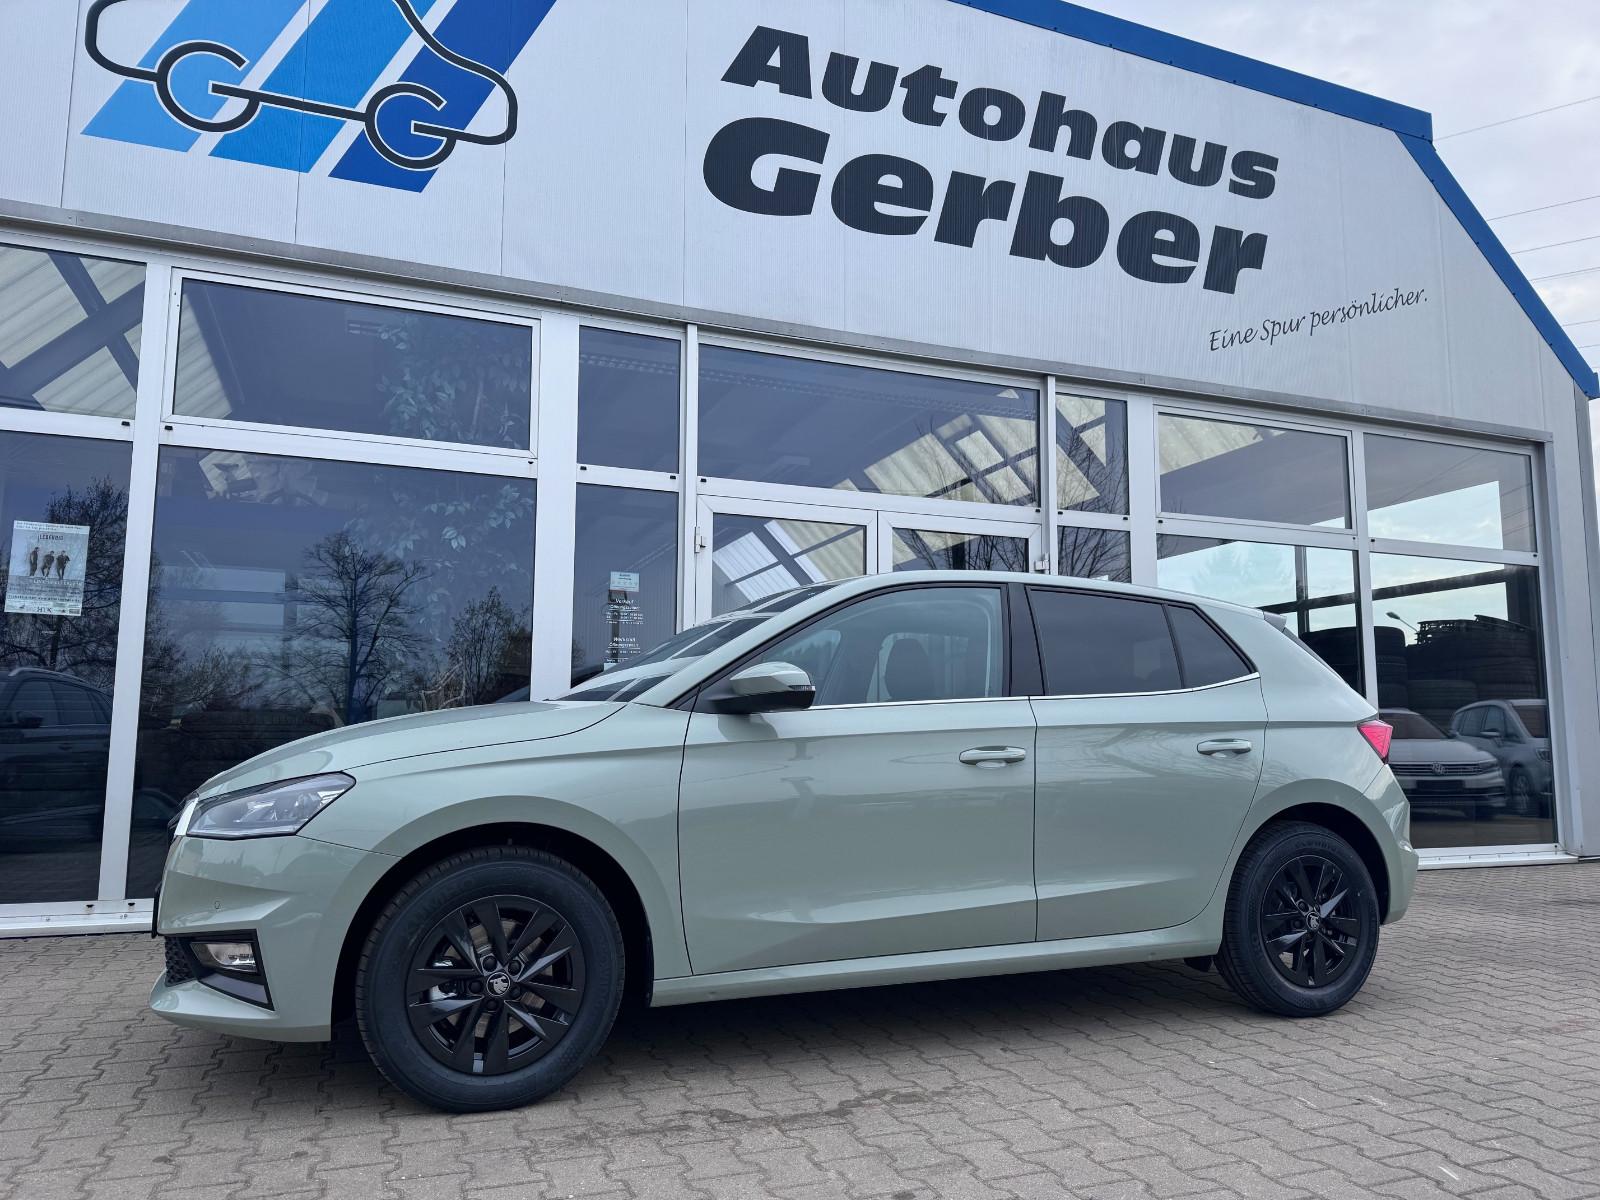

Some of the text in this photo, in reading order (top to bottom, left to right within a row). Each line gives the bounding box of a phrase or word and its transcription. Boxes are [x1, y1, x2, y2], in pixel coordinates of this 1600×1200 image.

[720, 25, 1279, 200] Autohaus
[702, 116, 1269, 295] Gerber
[1209, 287, 1428, 351] Eine Spur persönlicher.
